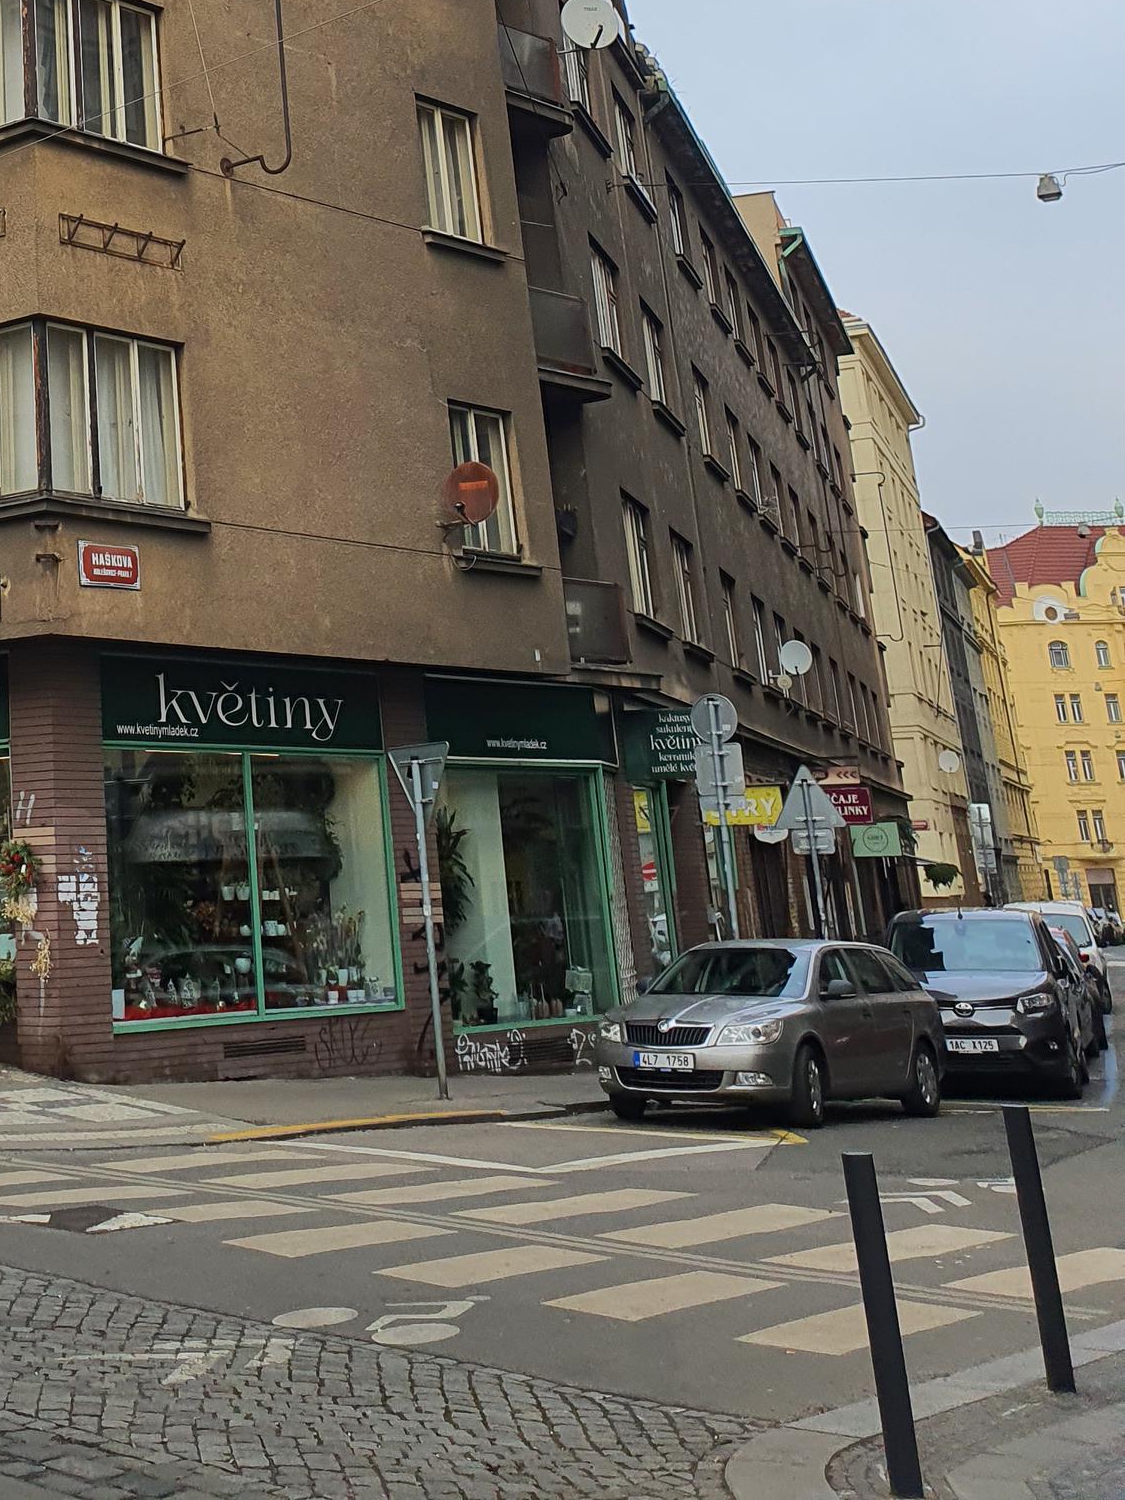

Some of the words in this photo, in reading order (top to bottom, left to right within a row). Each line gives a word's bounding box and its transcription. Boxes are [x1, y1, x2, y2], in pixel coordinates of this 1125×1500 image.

[91, 552, 133, 568] HAŠKOVA
[155, 672, 344, 741] květiny
[116, 722, 199, 738] www.kvetinymladek.cz
[836, 805, 869, 816] LINKY
[642, 1054, 658, 1066] 4L7
[666, 1055, 689, 1066] 1758
